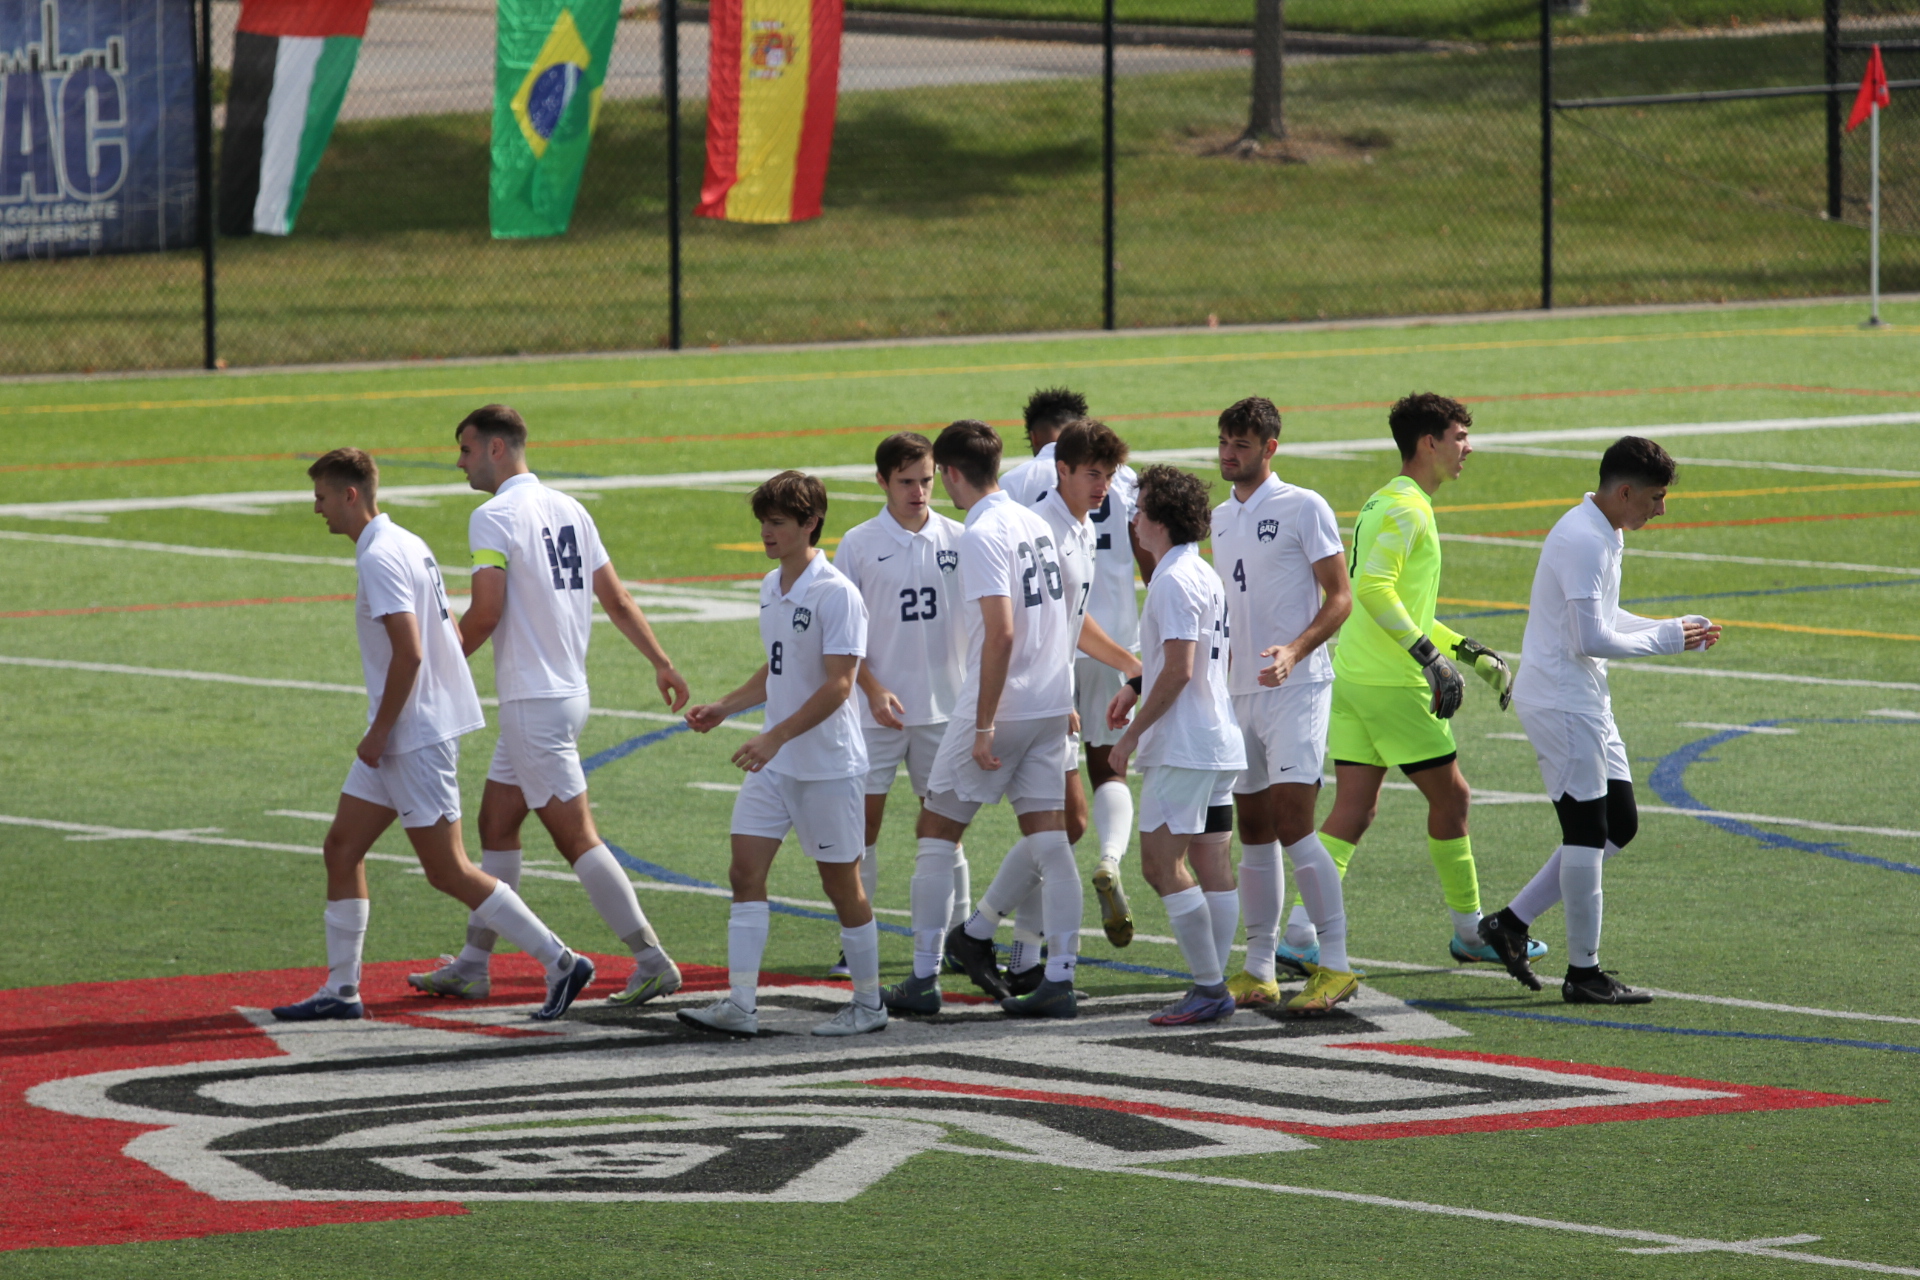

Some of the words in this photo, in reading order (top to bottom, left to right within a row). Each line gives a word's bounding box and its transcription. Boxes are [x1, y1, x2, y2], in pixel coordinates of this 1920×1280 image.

[5, 201, 118, 224] COLLEGIATE
[0, 222, 102, 244] NFERENCE
[542, 525, 583, 589] 14
[1018, 535, 1063, 607] 26
[1233, 558, 1246, 592] 4
[900, 587, 937, 622] 23
[1078, 583, 1089, 615] 7
[770, 641, 782, 675] 8
